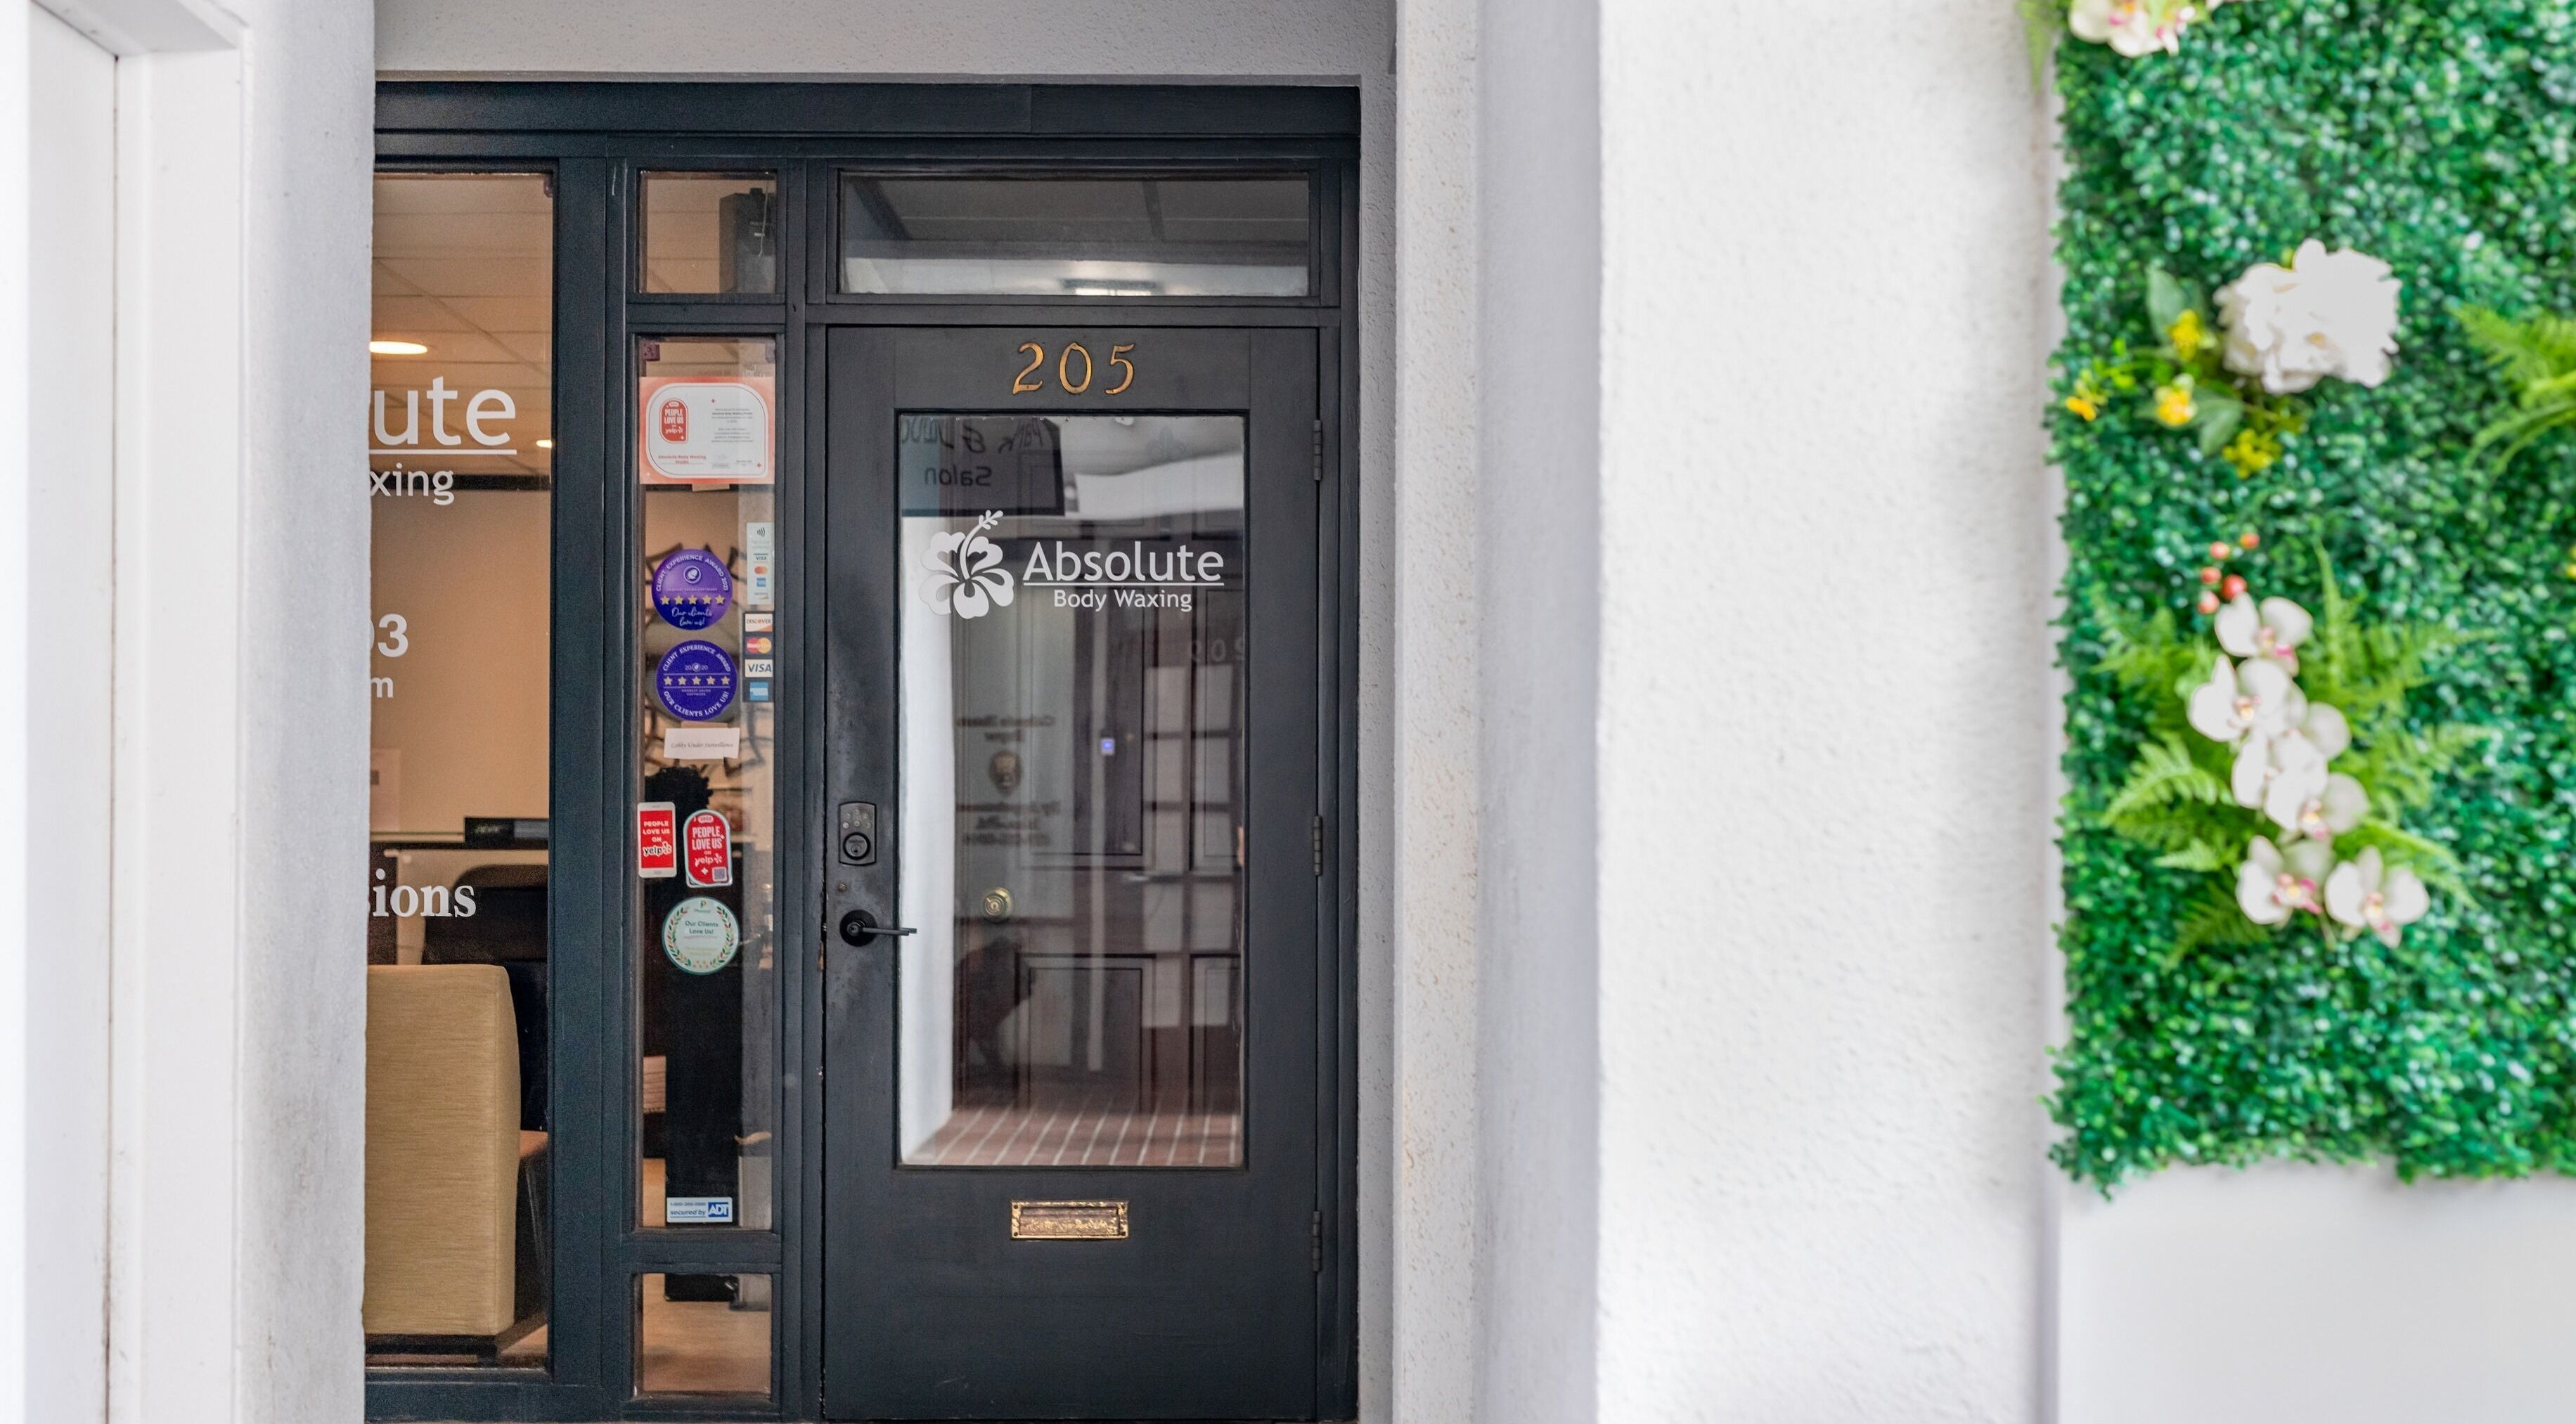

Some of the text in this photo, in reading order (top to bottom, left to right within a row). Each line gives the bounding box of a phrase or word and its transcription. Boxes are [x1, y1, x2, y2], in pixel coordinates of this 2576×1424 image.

[1012, 342, 1135, 395] 205
[374, 375, 516, 446] ute
[370, 462, 454, 506] xing
[655, 569, 666, 592] CLIENT
[666, 554, 703, 569] EXPERIENCE
[704, 558, 724, 576] AWARD
[1022, 541, 1225, 582] Absolute
[1054, 590, 1192, 612] Body Waxing
[370, 613, 408, 658] 3
[662, 645, 730, 672] CLIENT EXPERIENCE AWARD
[748, 664, 772, 672] VISA
[664, 690, 675, 706] OUR
[674, 704, 703, 716] CLIENTS
[704, 701, 722, 716] LOVE
[692, 826, 720, 838] PEOPLE
[692, 838, 722, 850] LOVE US
[643, 846, 662, 856] yelp
[695, 856, 713, 867] yelp
[368, 868, 477, 918] ions
[709, 1204, 728, 1215] ADT
